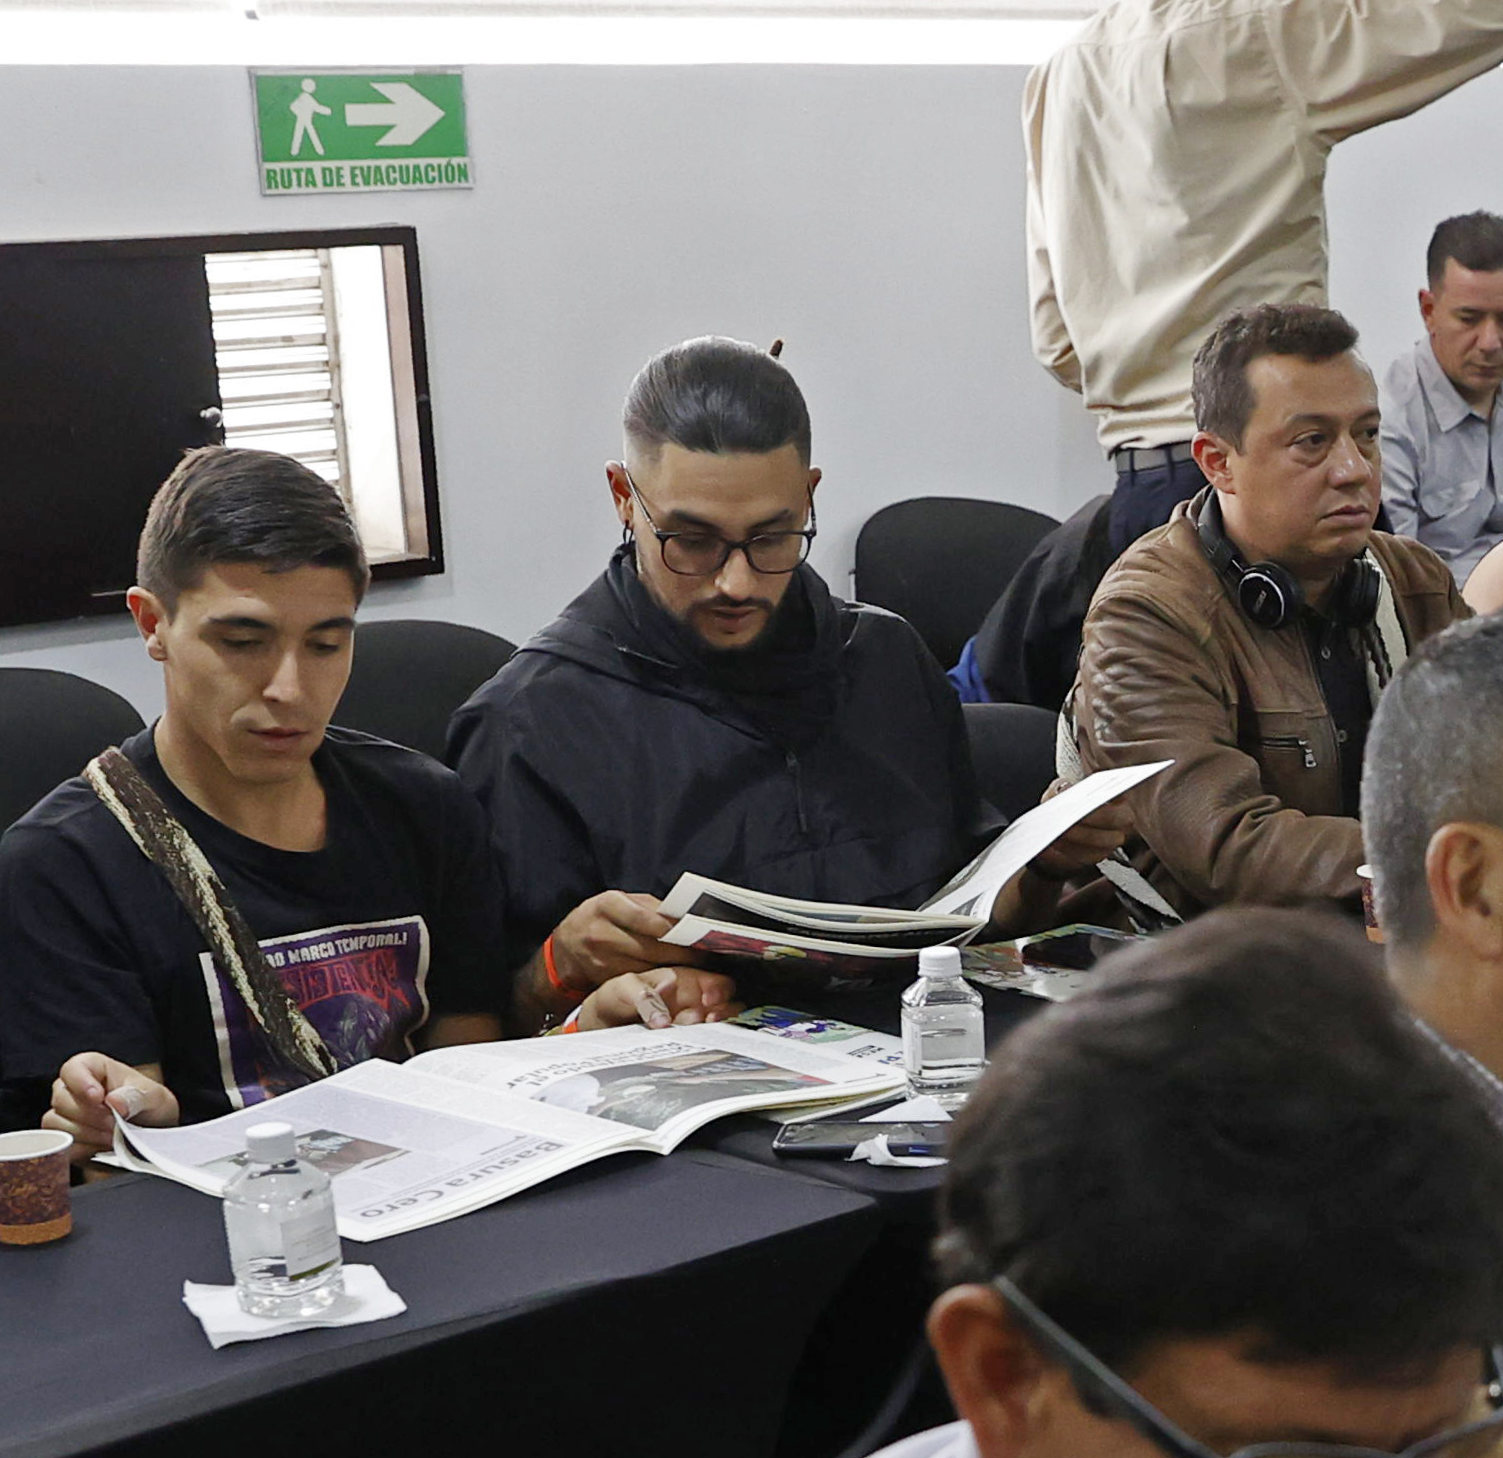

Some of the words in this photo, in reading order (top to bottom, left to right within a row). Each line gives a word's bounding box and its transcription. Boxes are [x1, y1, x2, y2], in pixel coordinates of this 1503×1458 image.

[265, 166, 317, 190] RUTA
[321, 165, 345, 188] DE
[350, 160, 469, 187] EVACUACIÓN
[288, 942, 336, 965] MARCO
[445, 1141, 564, 1187] Basura
[360, 1189, 445, 1218] Cero
